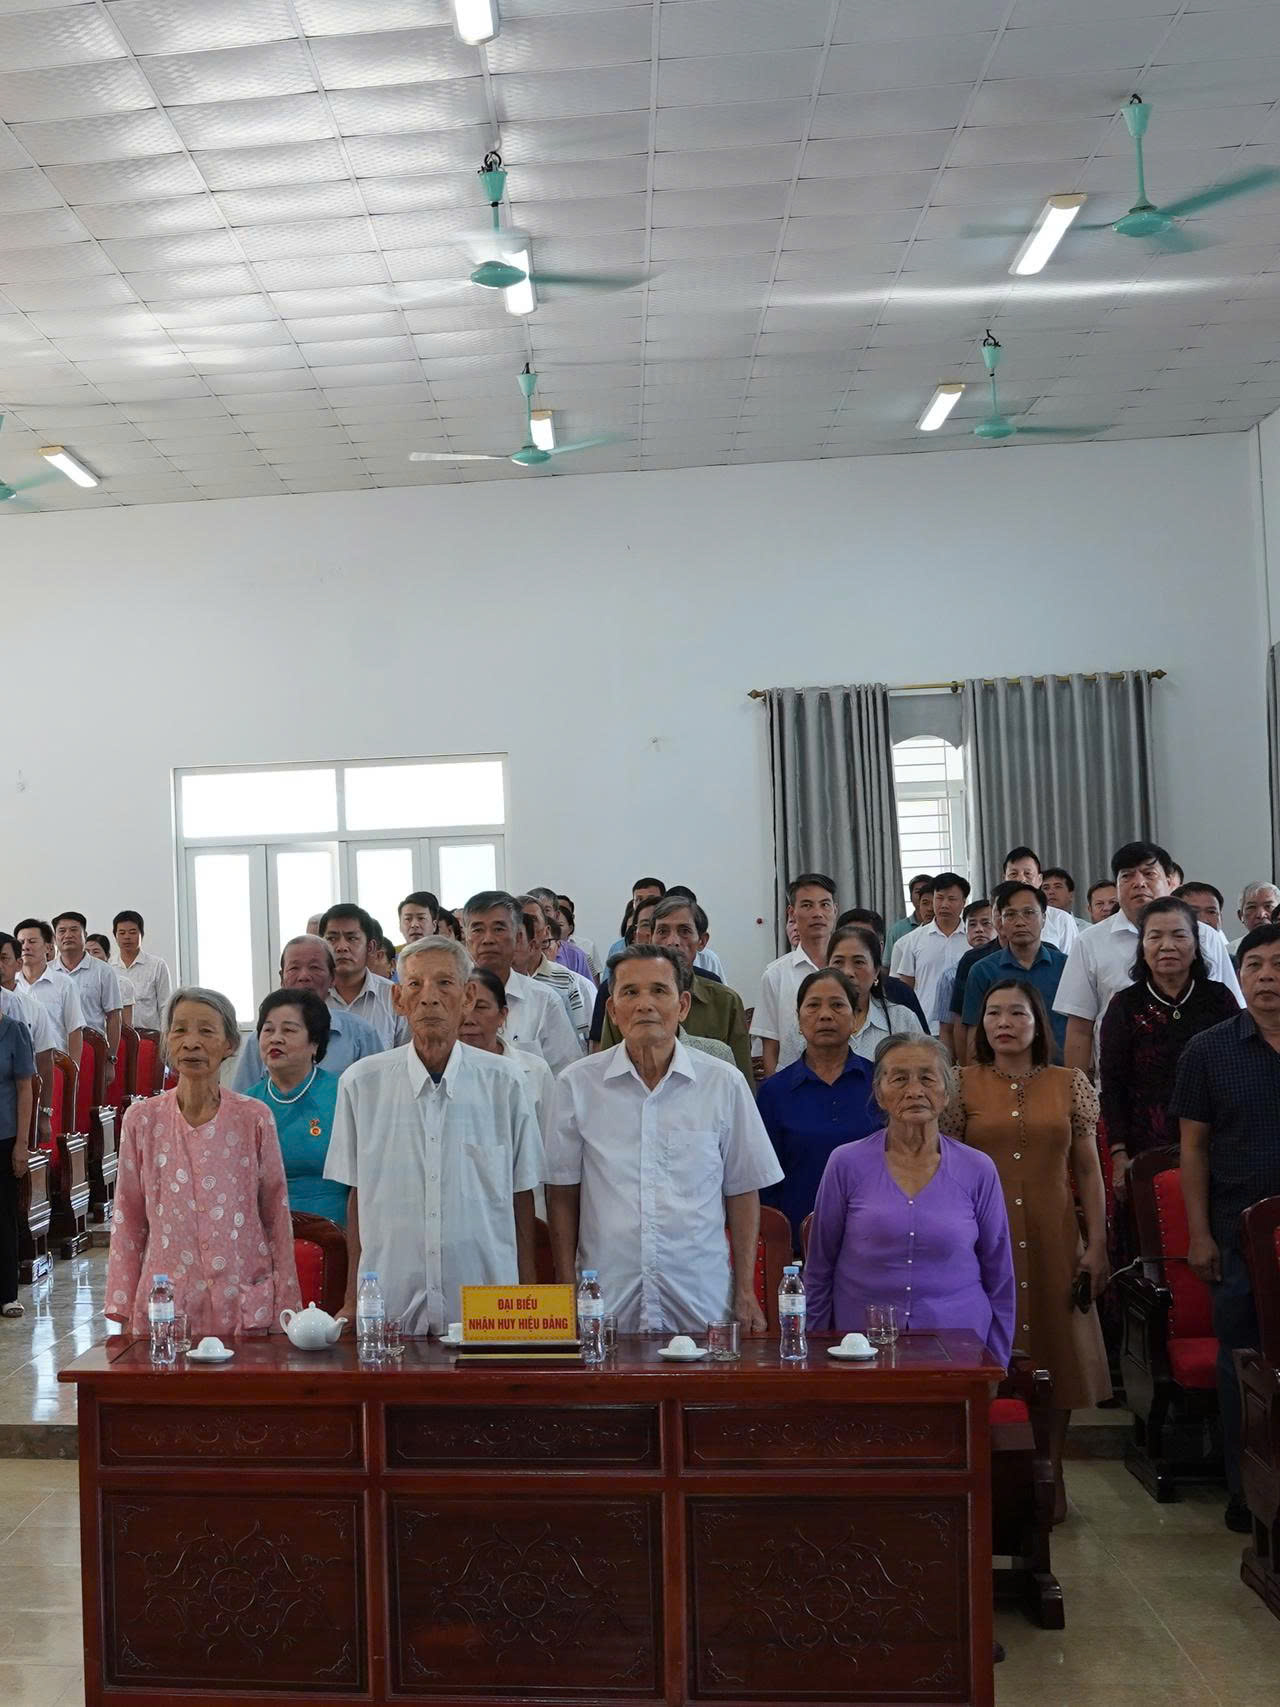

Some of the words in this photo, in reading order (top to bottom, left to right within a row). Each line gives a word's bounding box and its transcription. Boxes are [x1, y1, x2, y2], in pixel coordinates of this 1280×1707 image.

[498, 1298, 513, 1312] ĐẠI
[516, 1294, 538, 1310] BIỂU
[469, 1315, 495, 1332] NHẬN
[498, 1319, 516, 1329] HUY
[519, 1315, 539, 1332] HIỆU
[542, 1315, 568, 1329] ĐẢNG
